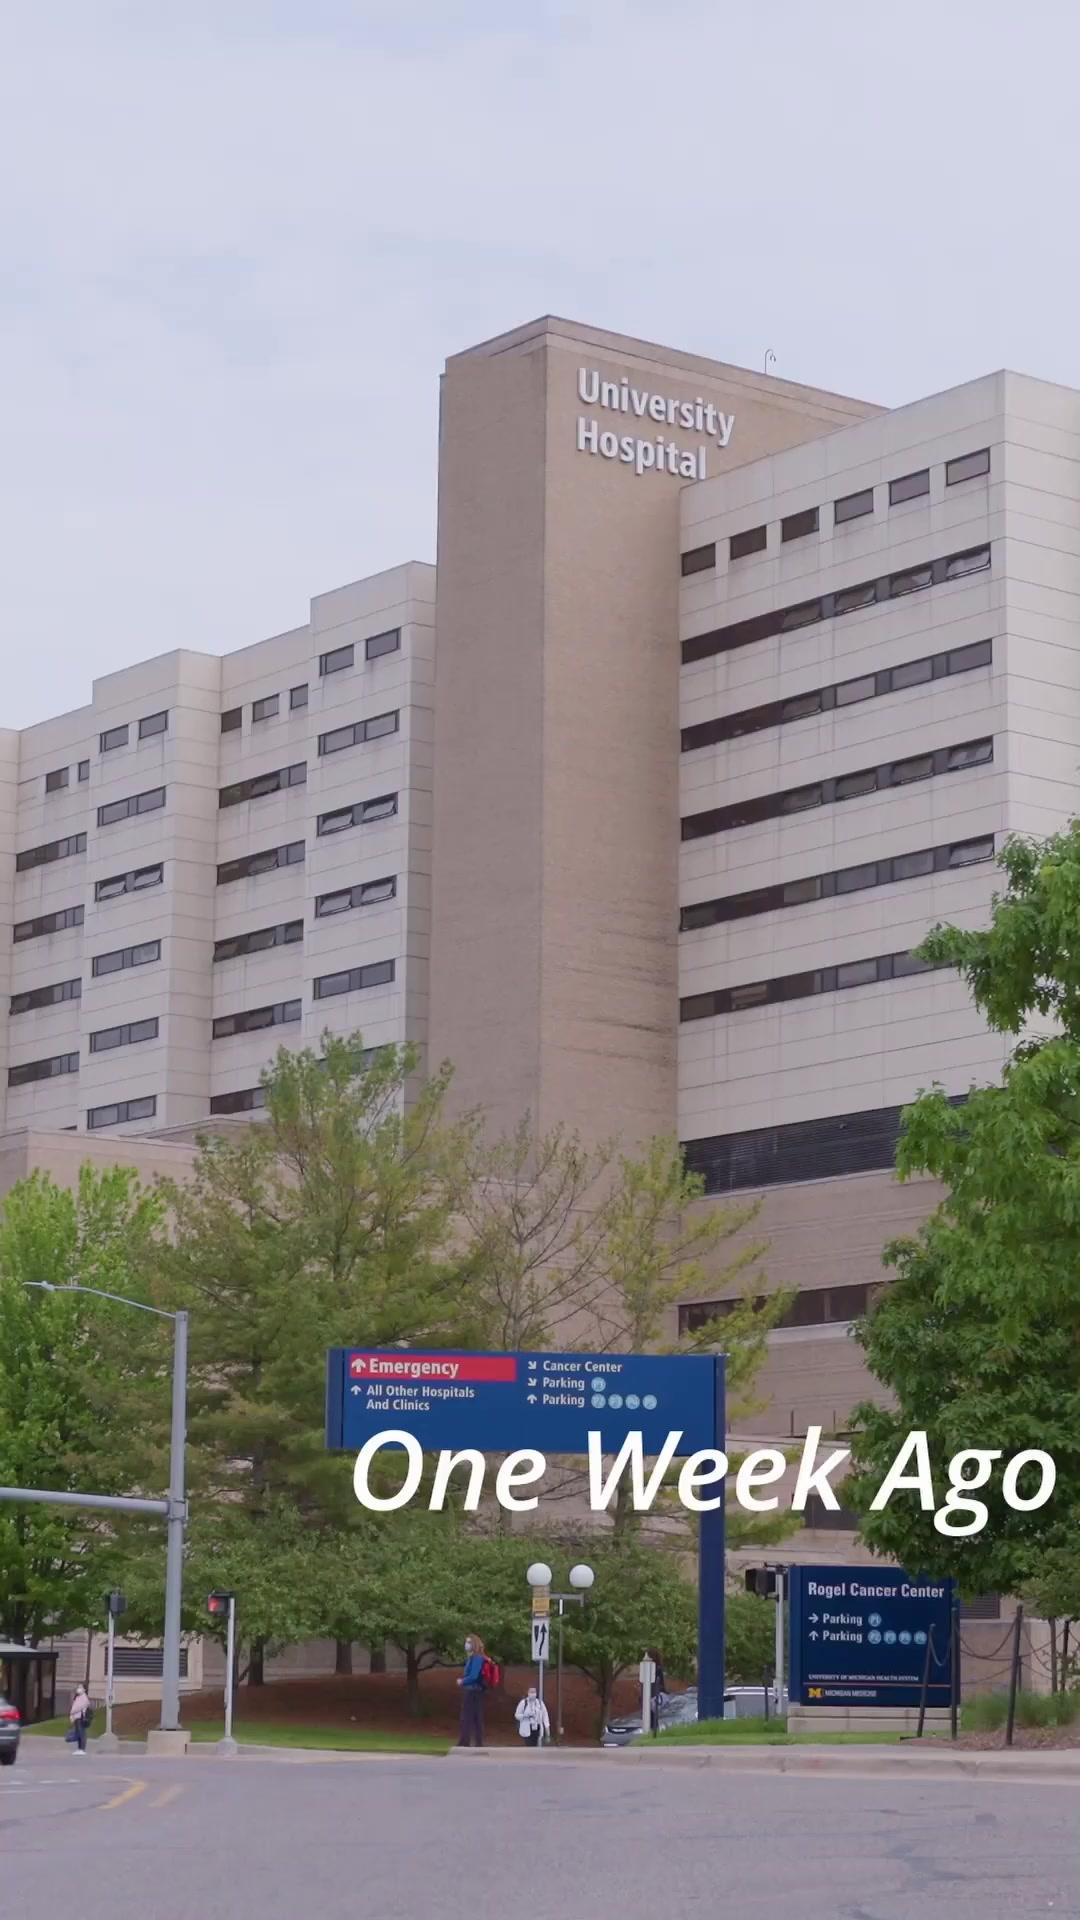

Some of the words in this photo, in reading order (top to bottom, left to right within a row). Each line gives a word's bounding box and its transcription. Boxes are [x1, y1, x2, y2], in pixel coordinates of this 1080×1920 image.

[577, 367, 735, 447] University
[576, 416, 707, 480] Hospital
[369, 1358, 459, 1379] Emergency
[543, 1360, 581, 1372] Cancer
[584, 1361, 622, 1373] Center
[543, 1377, 585, 1391] Parking
[366, 1385, 382, 1396] All
[386, 1385, 418, 1397] Other
[422, 1386, 475, 1399] Hospitals
[366, 1399, 389, 1410] And
[393, 1400, 430, 1411] Clinics
[543, 1394, 585, 1408] Parking
[808, 1582, 846, 1599] Rogel
[850, 1583, 898, 1597] Cancer
[901, 1584, 945, 1598] Center
[822, 1613, 863, 1627] Parking
[822, 1630, 863, 1644] Parking
